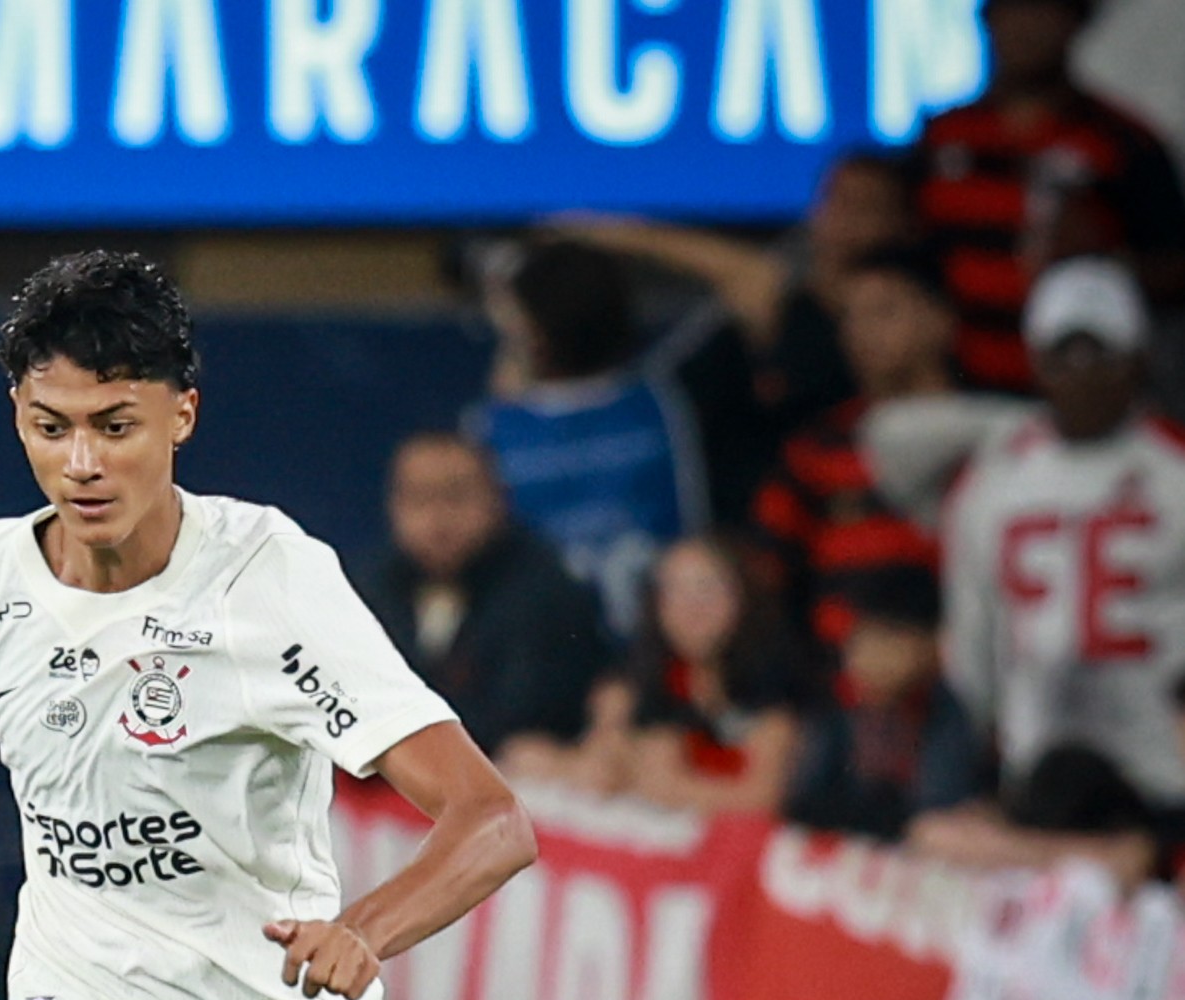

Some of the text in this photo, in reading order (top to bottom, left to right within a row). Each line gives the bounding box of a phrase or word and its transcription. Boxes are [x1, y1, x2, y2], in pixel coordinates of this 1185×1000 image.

[49, 646, 78, 672] Zé
[295, 664, 358, 738] bmg
[70, 847, 206, 888] Sorte
